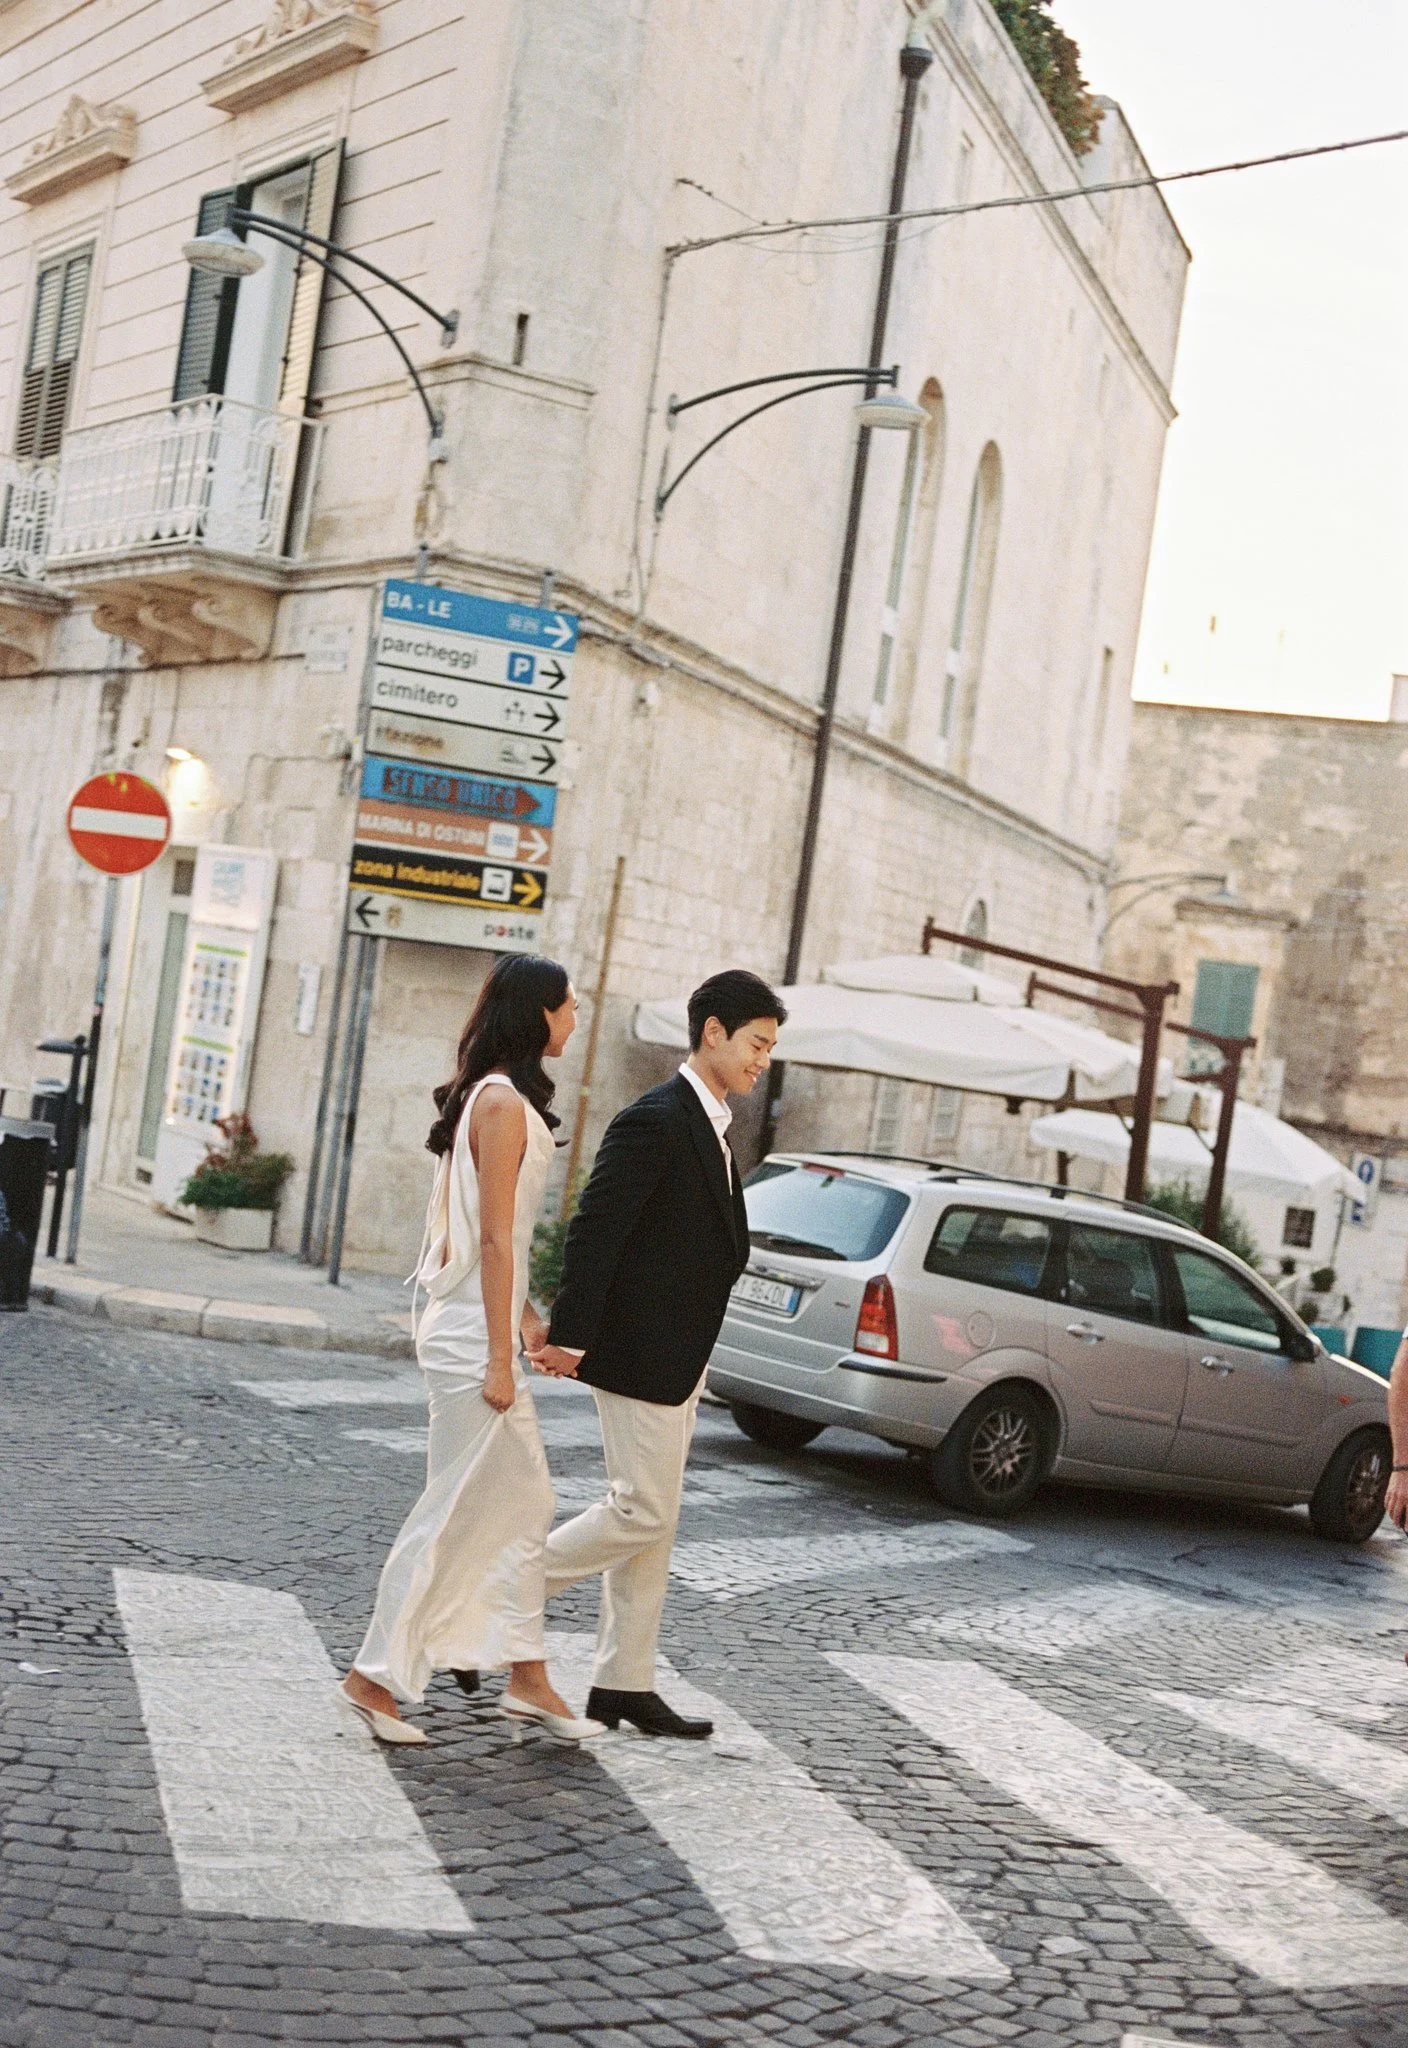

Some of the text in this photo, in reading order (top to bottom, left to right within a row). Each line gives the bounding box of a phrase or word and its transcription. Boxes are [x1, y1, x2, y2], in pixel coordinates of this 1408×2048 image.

[386, 591, 413, 611] BA
[427, 600, 452, 619] LE
[381, 637, 478, 669] parcheggi
[513, 656, 531, 678] P
[376, 680, 458, 708] cimitero
[353, 859, 482, 891] zona industriale
[484, 923, 536, 940] poste
